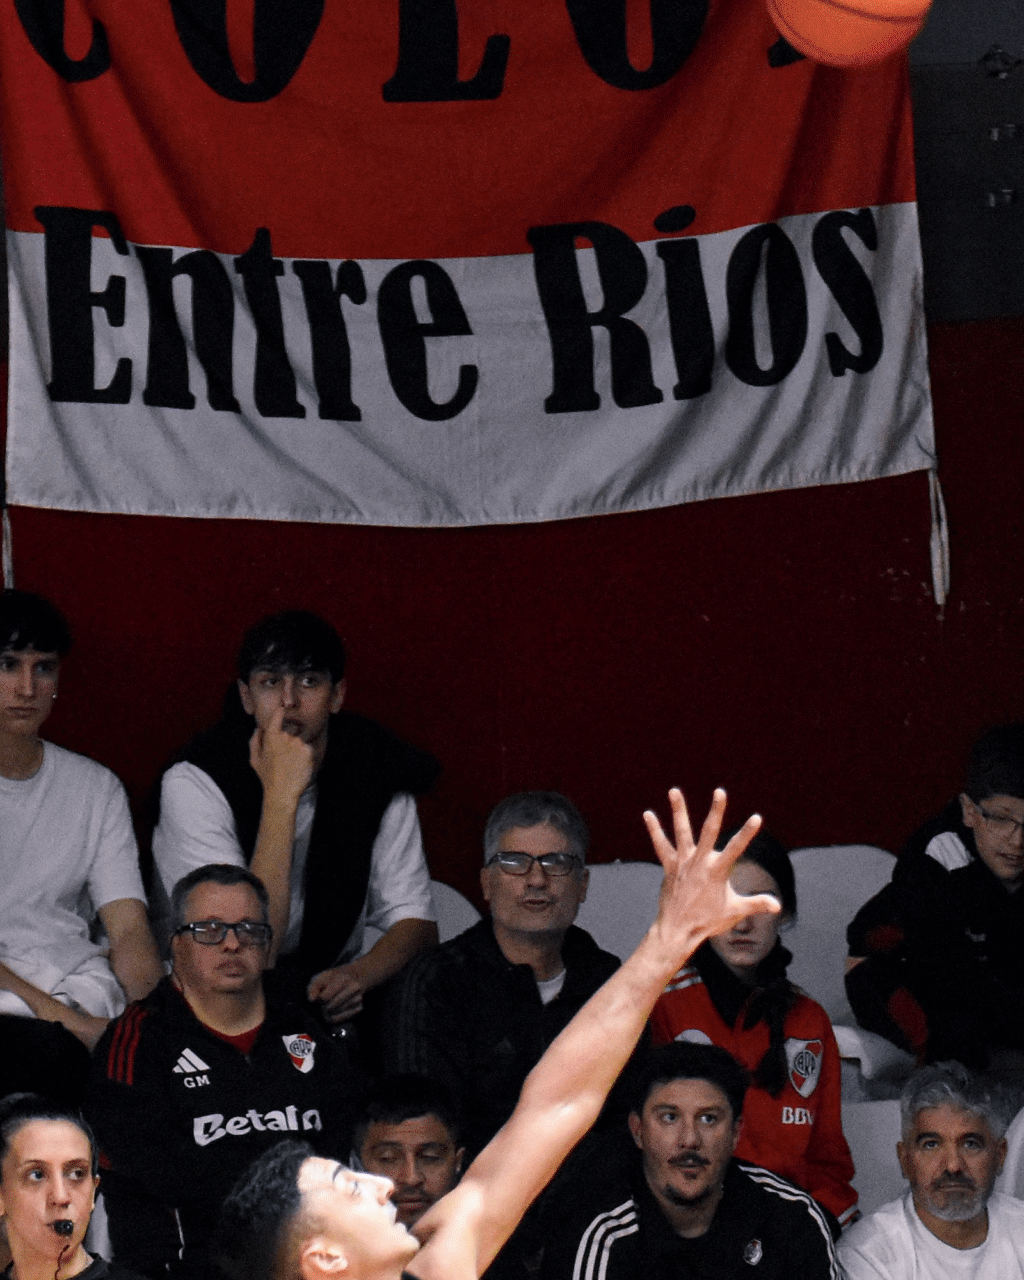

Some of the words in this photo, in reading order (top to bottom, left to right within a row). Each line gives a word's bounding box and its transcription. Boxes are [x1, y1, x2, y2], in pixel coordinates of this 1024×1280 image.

[34, 205, 479, 422] Entre
[526, 204, 885, 414] Rios
[184, 1074, 211, 1088] GM
